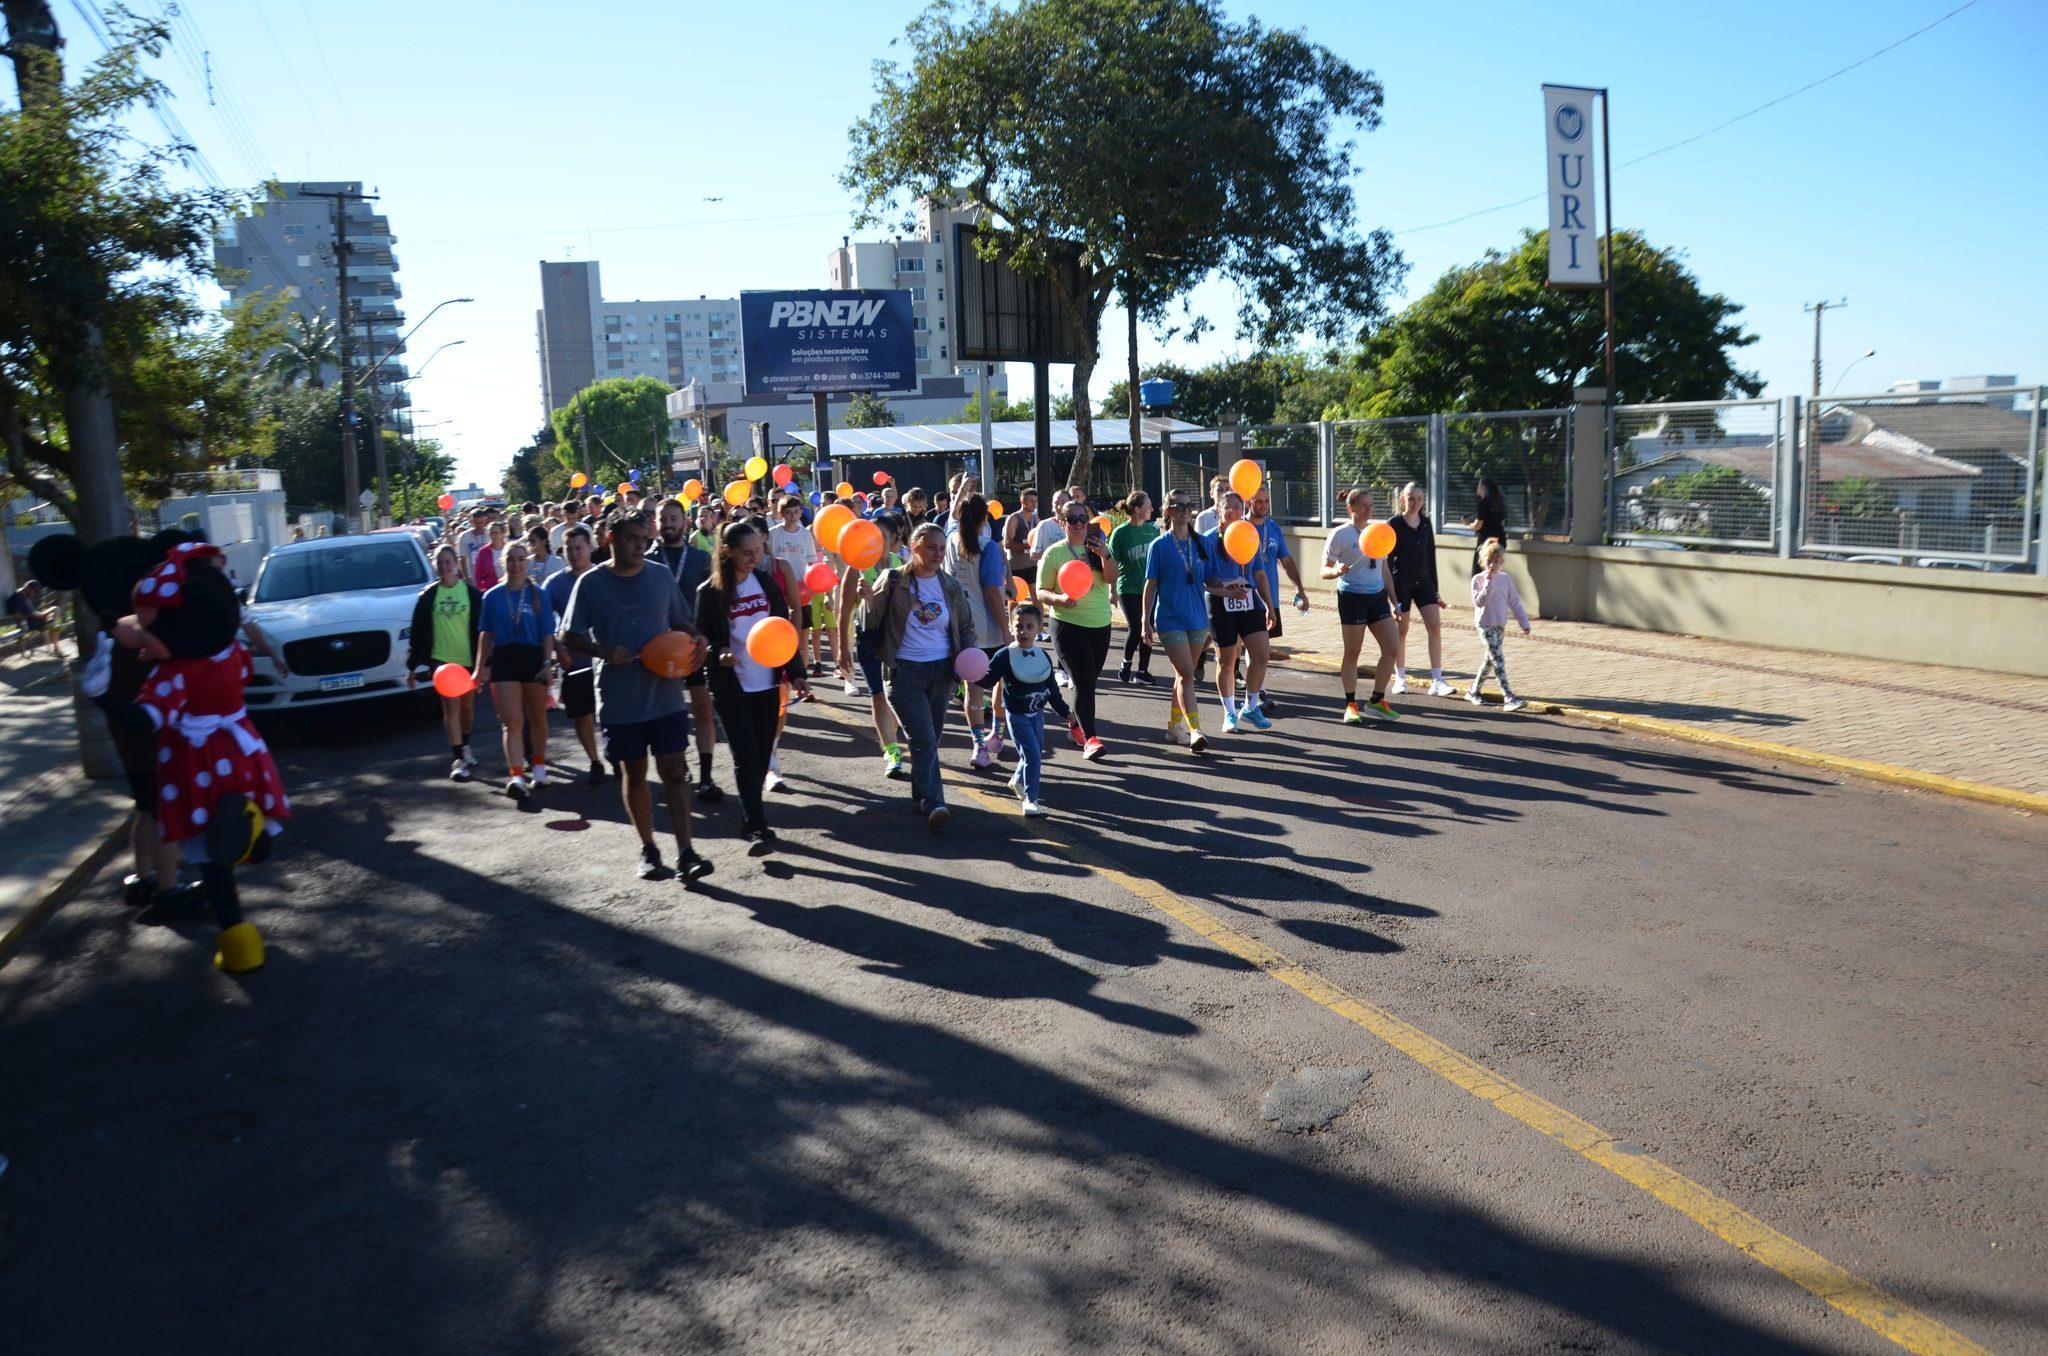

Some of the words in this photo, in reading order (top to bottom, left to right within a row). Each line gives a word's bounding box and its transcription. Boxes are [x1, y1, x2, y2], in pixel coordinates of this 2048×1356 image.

[1558, 154, 1586, 269] URI
[769, 300, 886, 328] PBNEW
[798, 328, 887, 340] SISTEMAS
[791, 348, 823, 357] Soluções
[824, 346, 869, 355] tecnológicas
[803, 355, 834, 364] produtos
[769, 375, 810, 383] pbnew.com.br
[864, 371, 900, 380] 3744-3880
